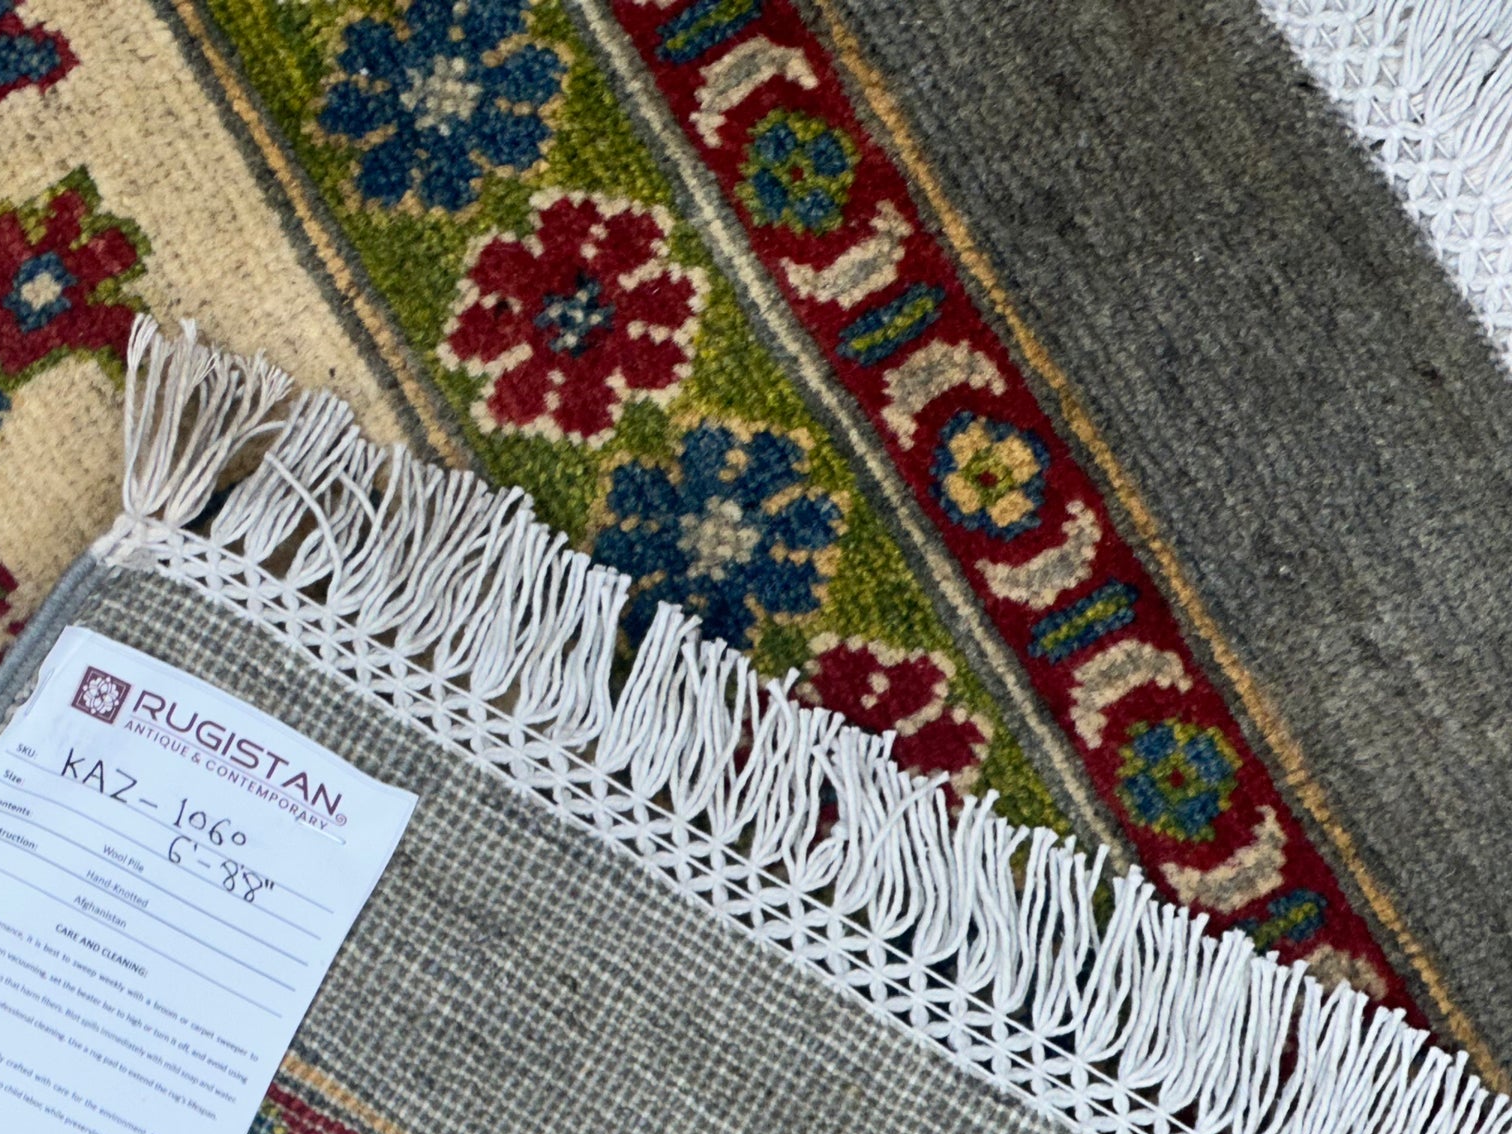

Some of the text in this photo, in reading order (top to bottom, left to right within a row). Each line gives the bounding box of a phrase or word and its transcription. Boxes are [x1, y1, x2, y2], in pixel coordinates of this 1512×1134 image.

[2, 768, 24, 785] Size:
[15, 742, 38, 759] SKU:
[123, 718, 328, 831] ANTIQUE & CONTEMPORARY
[132, 688, 342, 816] RUGISTAN
[102, 844, 145, 873] Wool Pile
[72, 894, 127, 929] Afghanistan
[83, 868, 149, 909] Hand-Knotted
[54, 922, 148, 978] CARE AND CLEANING:
[6, 951, 48, 979] vacuuming,
[48, 973, 62, 986] set
[61, 979, 76, 993] the
[75, 986, 102, 1006] beater
[101, 1000, 116, 1013] bar
[115, 1008, 125, 1019] to
[124, 1012, 143, 1029] high
[142, 1023, 153, 1032] or
[152, 1027, 170, 1043] turn
[169, 1036, 177, 1046] it
[176, 1040, 191, 1055] off,
[190, 1047, 207, 1061] and
[205, 1056, 228, 1072] avoid
[226, 1067, 248, 1085] using
[25, 933, 34, 943] it
[33, 937, 42, 948] is
[42, 942, 61, 958] best
[60, 952, 71, 963] to
[71, 959, 97, 978] sweep
[97, 972, 125, 992] weekly
[126, 987, 144, 1002] with
[144, 997, 152, 1006] a
[152, 1000, 178, 1020] broom
[178, 1016, 189, 1025] or
[189, 1021, 215, 1039] carpet
[215, 1035, 248, 1057] sweeper
[248, 1051, 259, 1062] to
[3, 976, 20, 990] that
[19, 984, 41, 1001] harm
[40, 994, 66, 1014] fibers.
[63, 1007, 81, 1022] Blot
[79, 1016, 100, 1033] spills
[99, 1026, 146, 1057] immediately
[145, 1050, 164, 1065] with
[162, 1060, 181, 1074] mild
[179, 1069, 199, 1085] soap
[198, 1078, 215, 1092] and
[213, 1087, 236, 1104] water.
[5, 1057, 34, 1077] crafted
[33, 1072, 51, 1087] with
[52, 1083, 70, 1096] care
[70, 1090, 84, 1103] for
[83, 1098, 98, 1111] the
